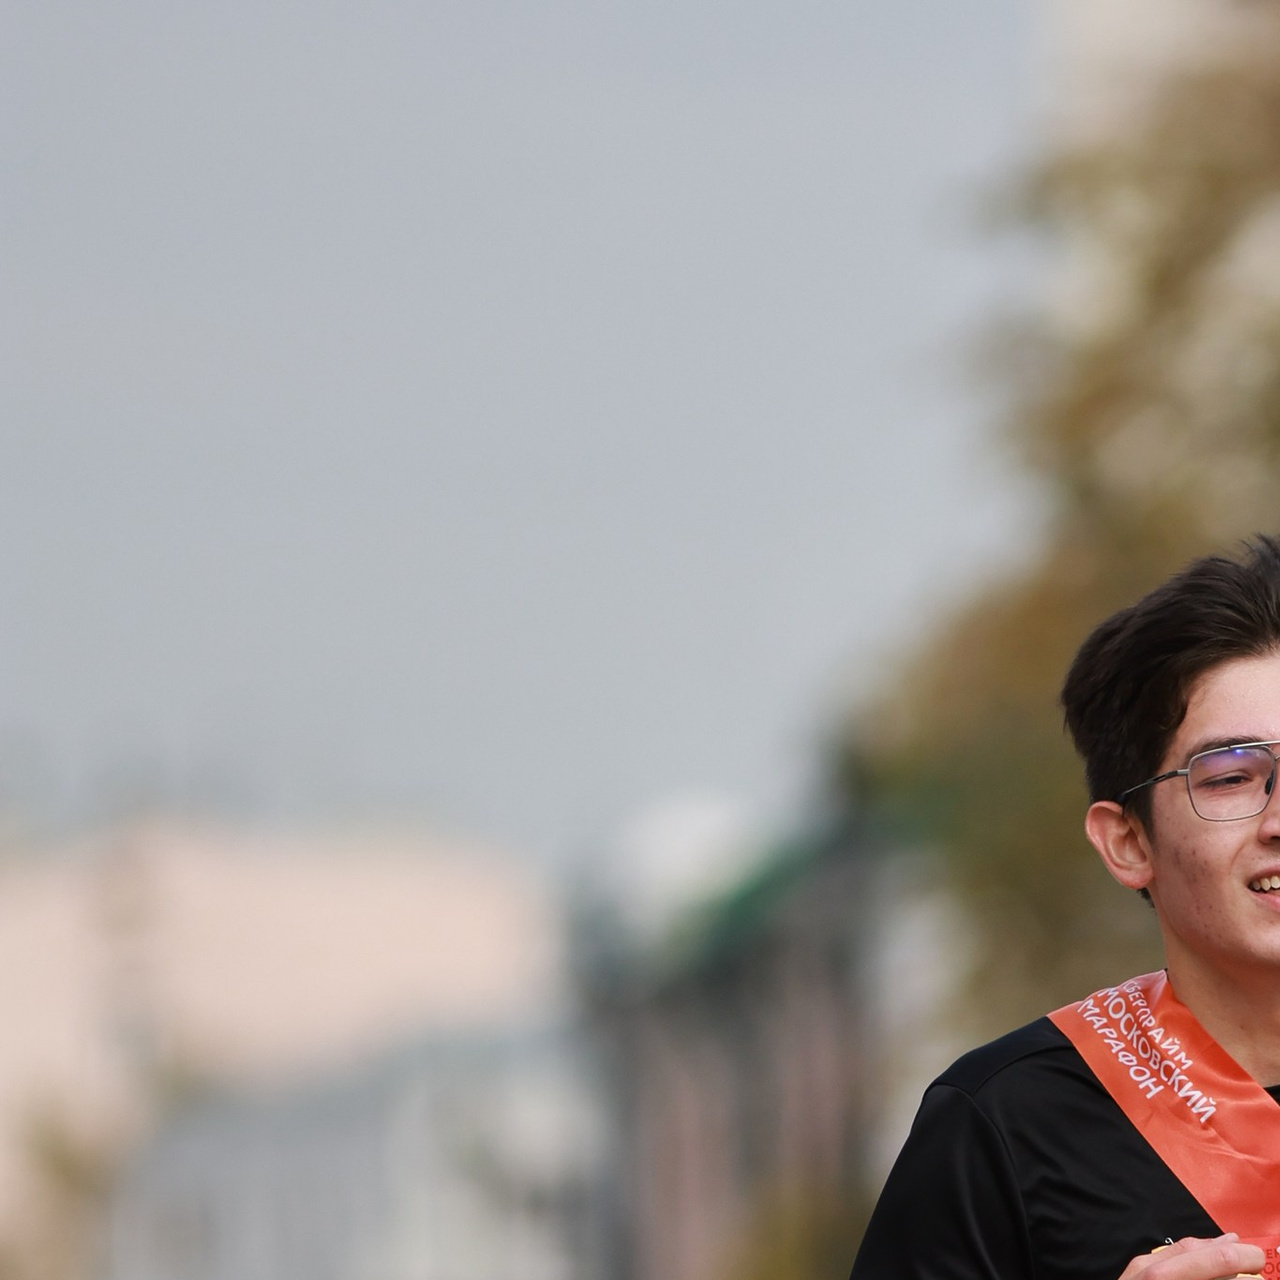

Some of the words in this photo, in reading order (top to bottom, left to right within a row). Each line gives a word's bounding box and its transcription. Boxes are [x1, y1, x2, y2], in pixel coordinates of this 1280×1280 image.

[1077, 998, 1165, 1100] МАРАФОН
[1096, 987, 1217, 1124] МОСКОВСКИЙ
[1122, 979, 1194, 1071] СБЕРПРАЙМ
